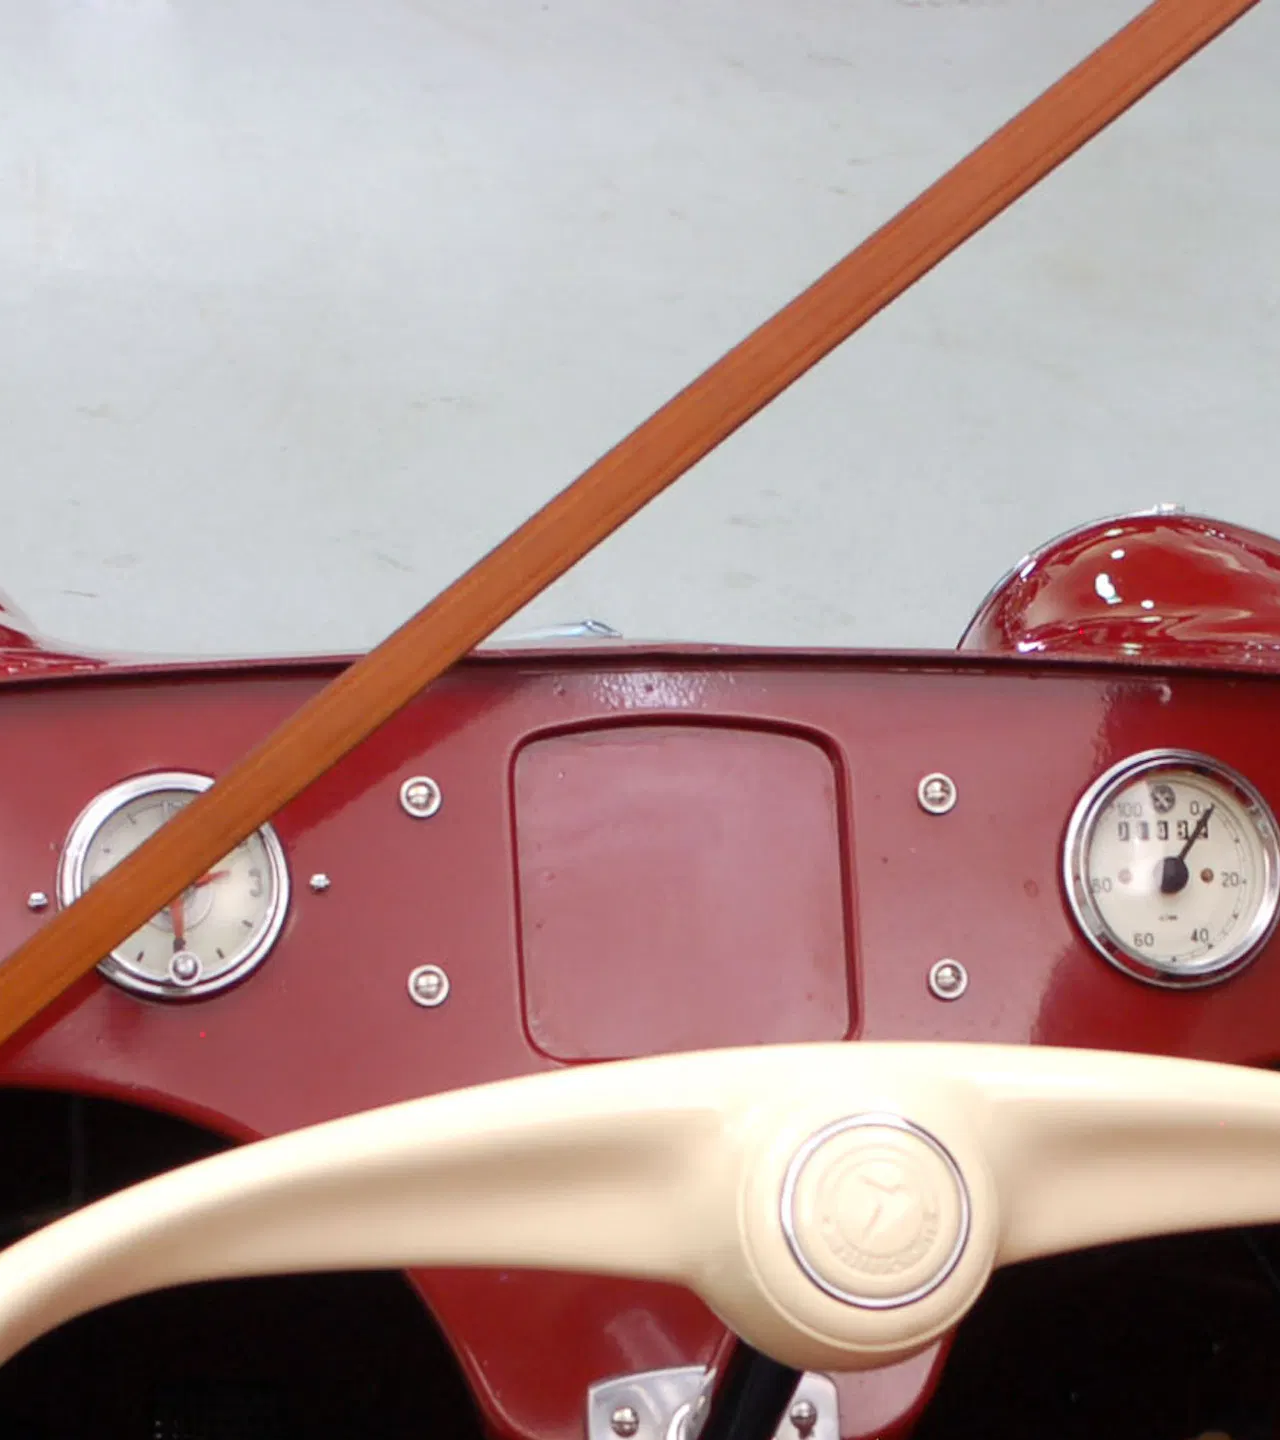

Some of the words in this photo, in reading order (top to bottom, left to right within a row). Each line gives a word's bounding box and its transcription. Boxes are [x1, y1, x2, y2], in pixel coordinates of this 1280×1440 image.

[1118, 802, 1142, 817] 100
[1221, 871, 1239, 888] 20
[1133, 932, 1155, 948] 60
[1190, 928, 1209, 943] 40
